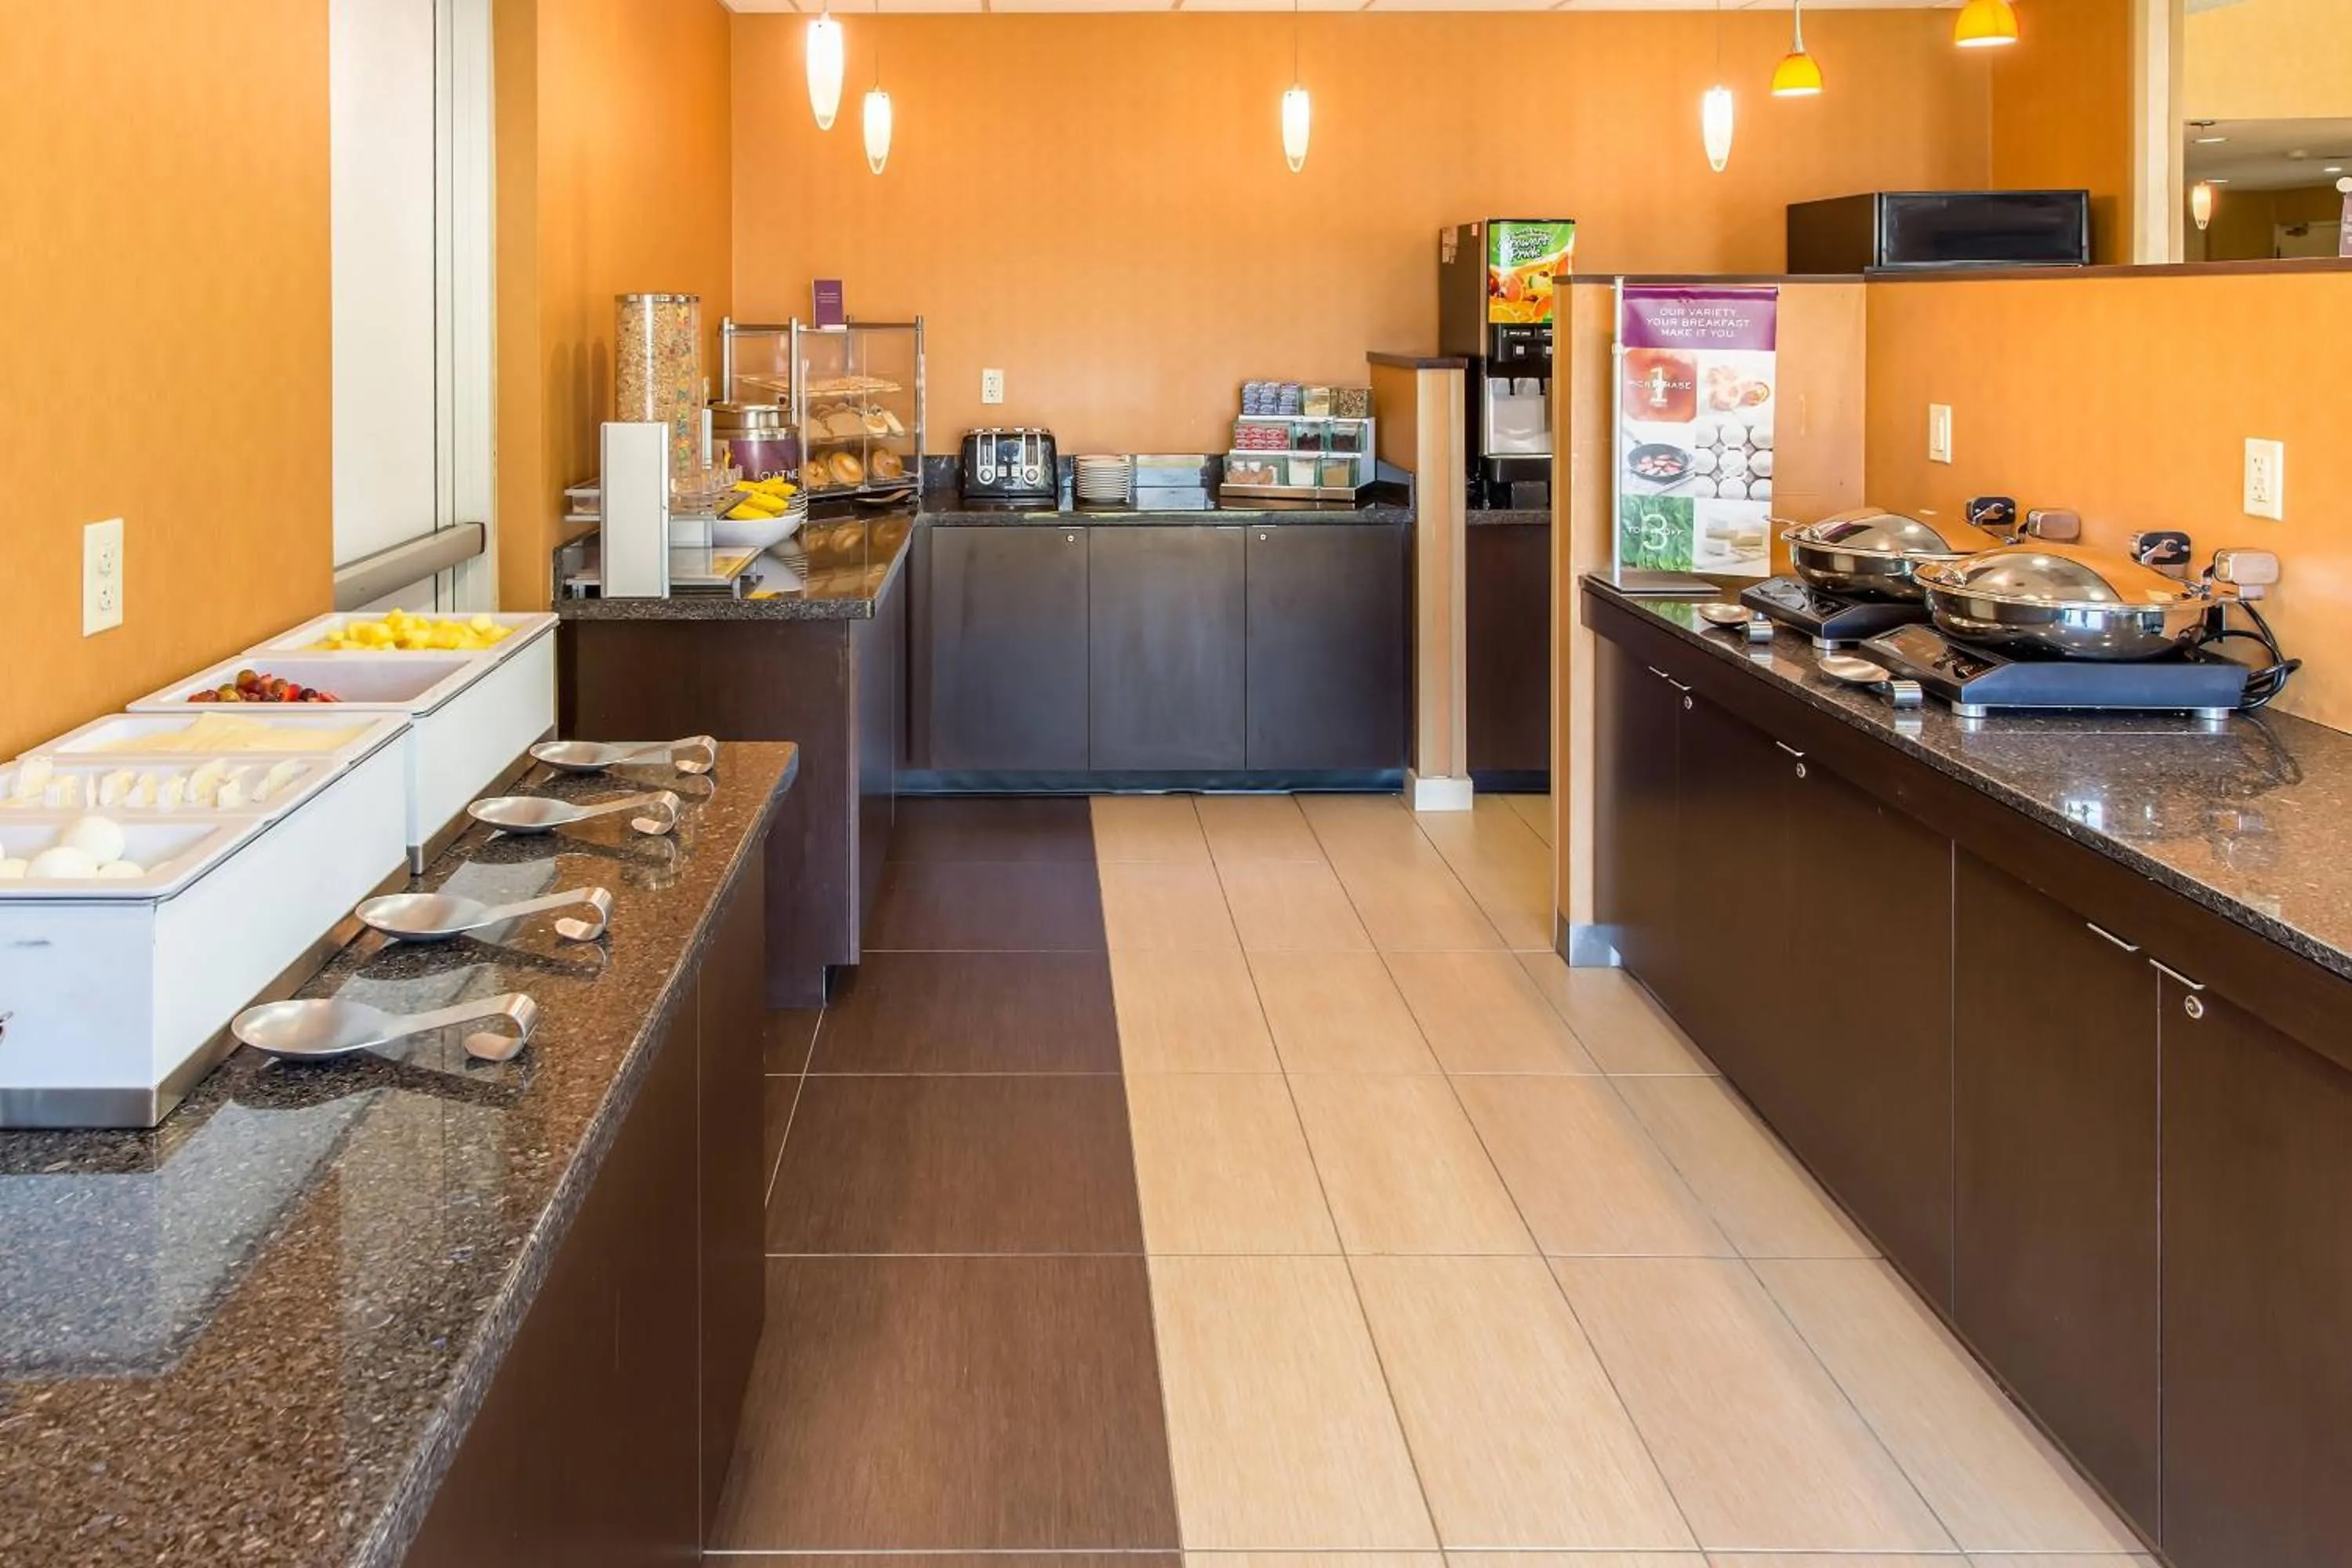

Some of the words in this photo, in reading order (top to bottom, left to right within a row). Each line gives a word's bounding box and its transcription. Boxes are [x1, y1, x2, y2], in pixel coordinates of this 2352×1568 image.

[1660, 307, 1686, 316] OUR
[1646, 317, 1679, 327] YOUR
[1661, 328, 1693, 337] MAKE
[1696, 328, 1707, 337] IT
[1643, 514, 1668, 550] 3
